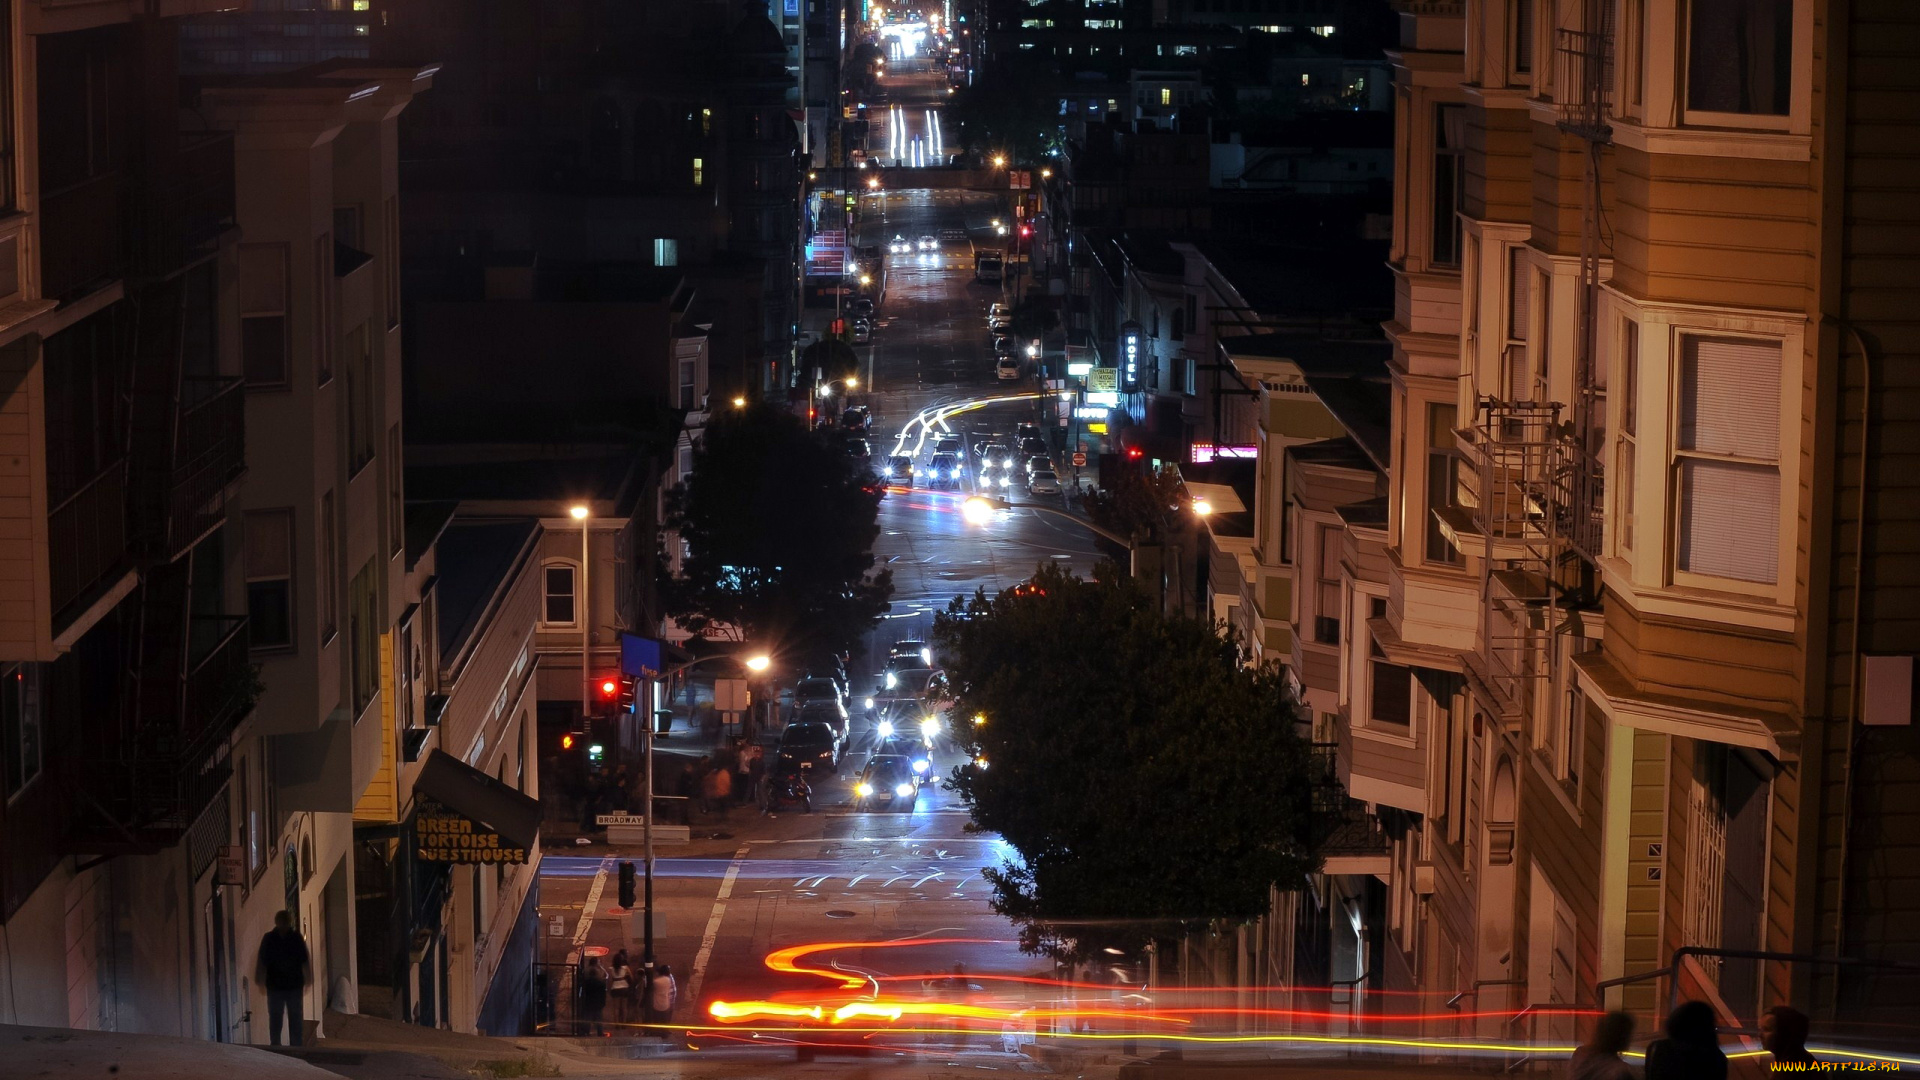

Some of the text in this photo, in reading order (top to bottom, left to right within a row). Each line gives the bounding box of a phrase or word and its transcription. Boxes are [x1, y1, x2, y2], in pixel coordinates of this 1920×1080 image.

[1127, 336, 1136, 382] HOTEL
[416, 819, 472, 833] GREEN
[598, 816, 642, 824] BROADWAY
[417, 833, 499, 848] TORTOISE
[219, 847, 229, 856] NO
[418, 848, 524, 862] GUESTHOUSE
